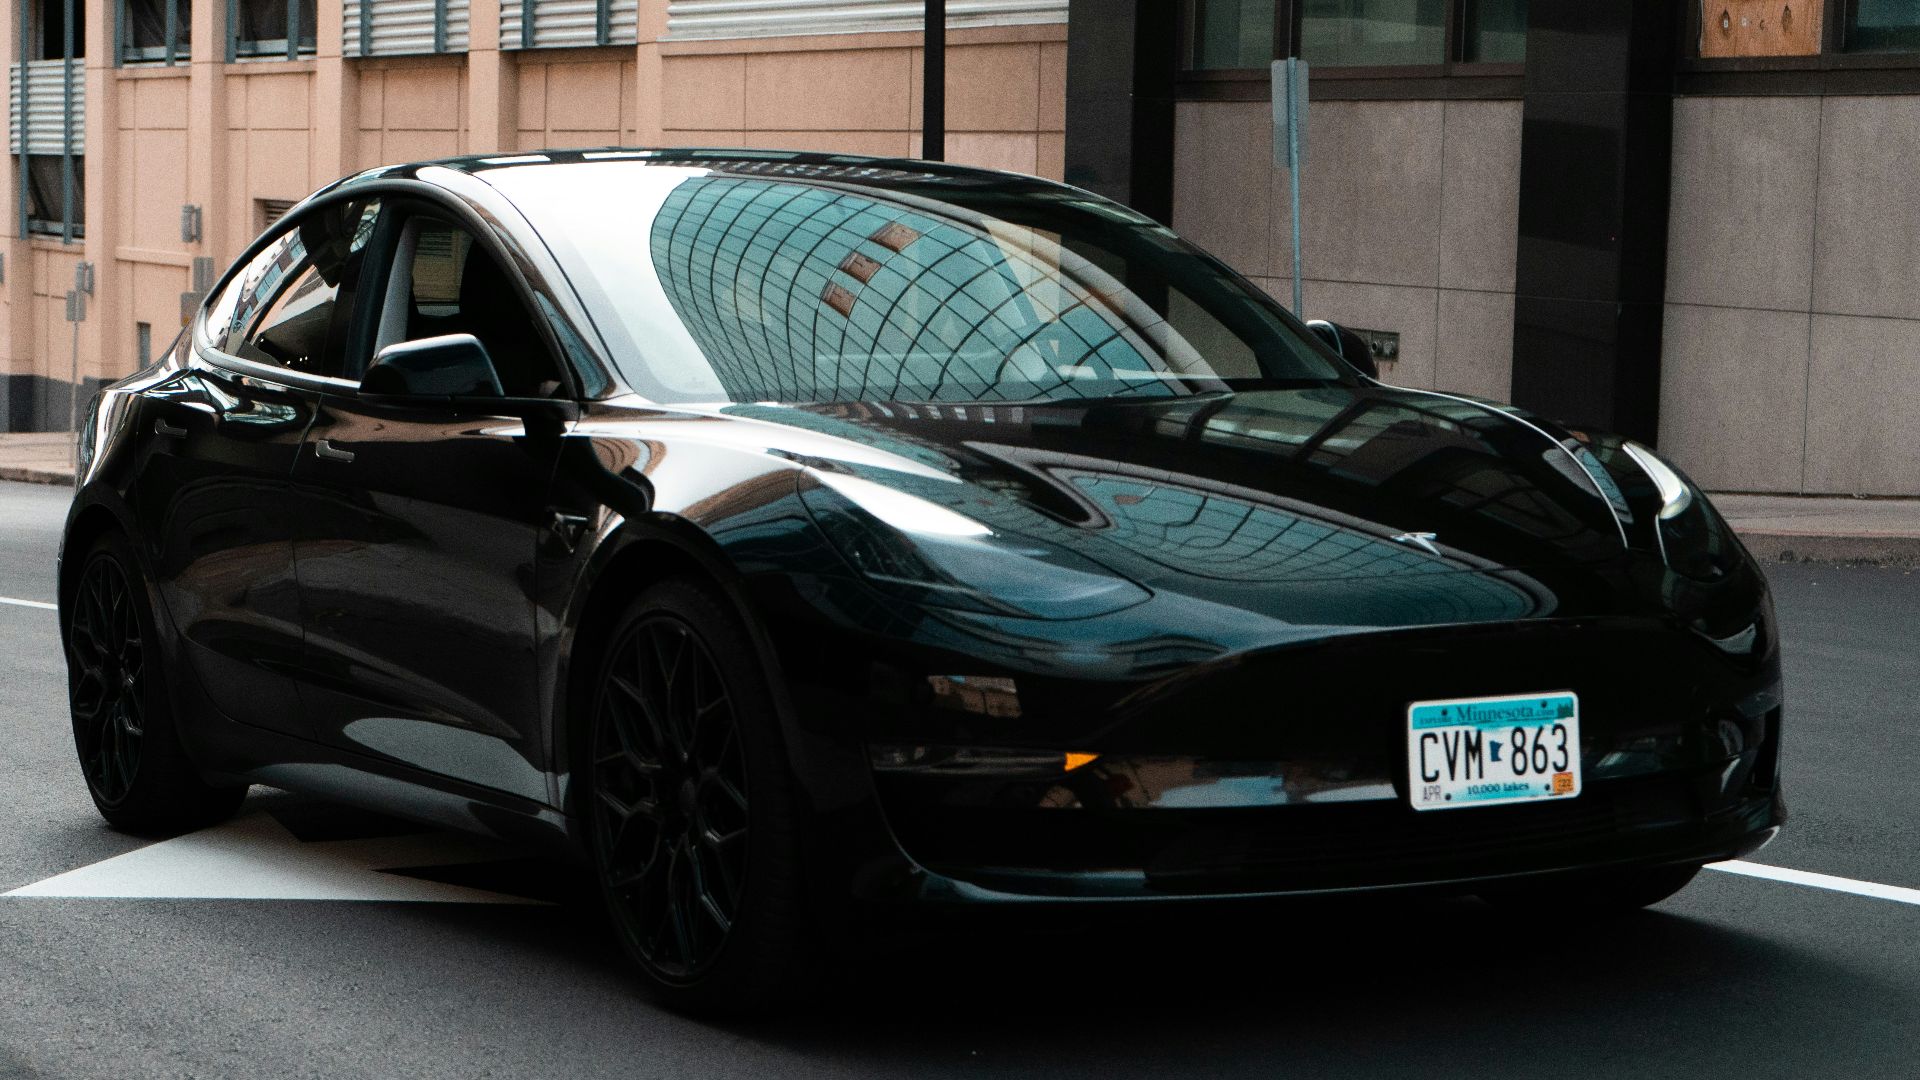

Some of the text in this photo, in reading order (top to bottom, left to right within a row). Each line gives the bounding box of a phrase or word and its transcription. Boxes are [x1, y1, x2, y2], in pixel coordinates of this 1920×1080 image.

[1456, 705, 1533, 721] Minnesota
[1420, 723, 1569, 783] CVM 863
[1423, 785, 1442, 801] APR
